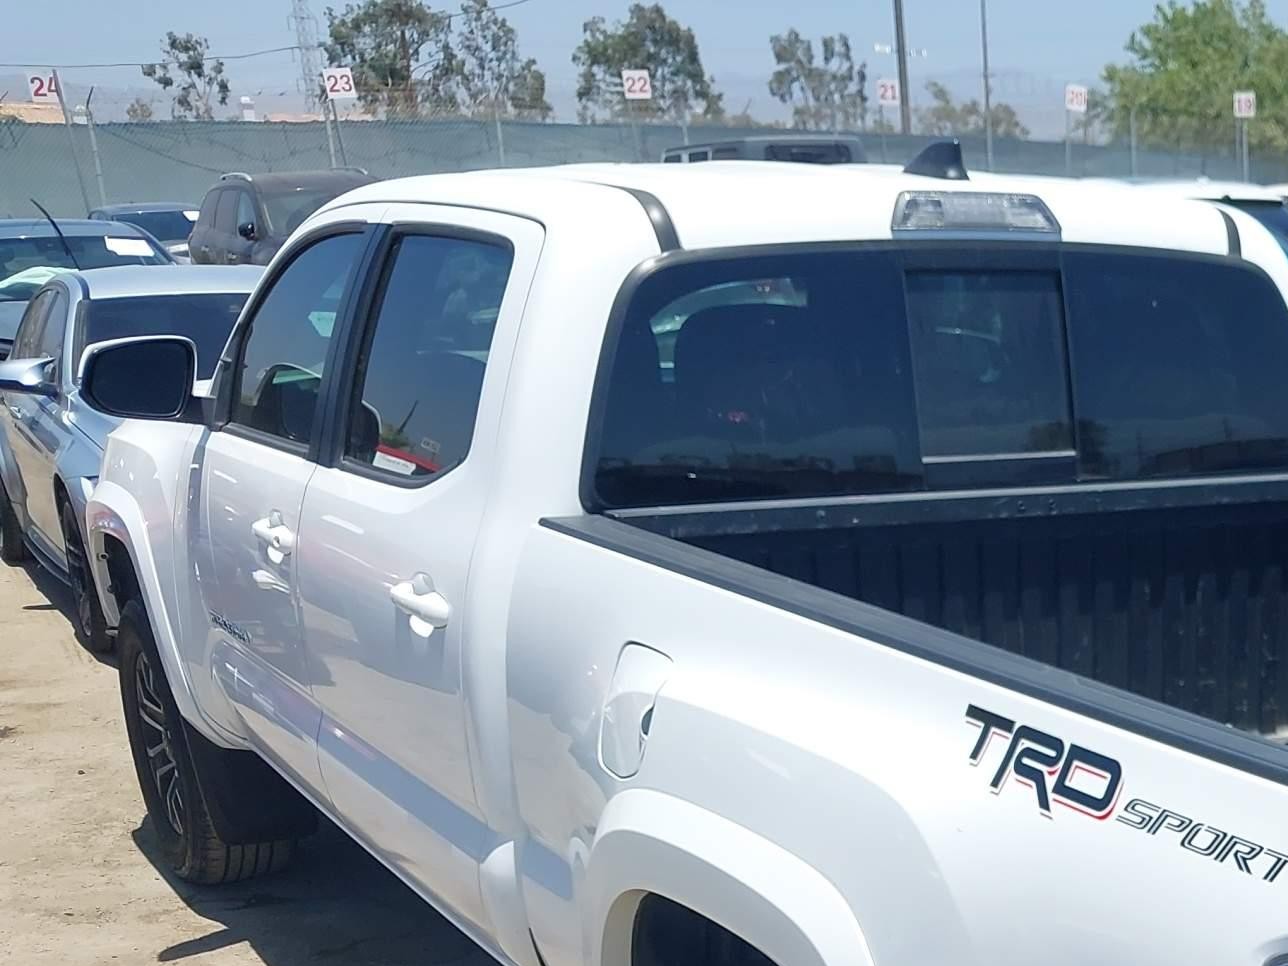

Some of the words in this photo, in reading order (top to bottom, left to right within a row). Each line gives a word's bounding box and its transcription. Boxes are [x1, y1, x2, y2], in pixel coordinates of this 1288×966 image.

[30, 76, 60, 97] 24
[327, 75, 353, 92] 23
[625, 76, 648, 93] 22
[880, 84, 897, 101] 21
[965, 703, 1124, 820] TRD
